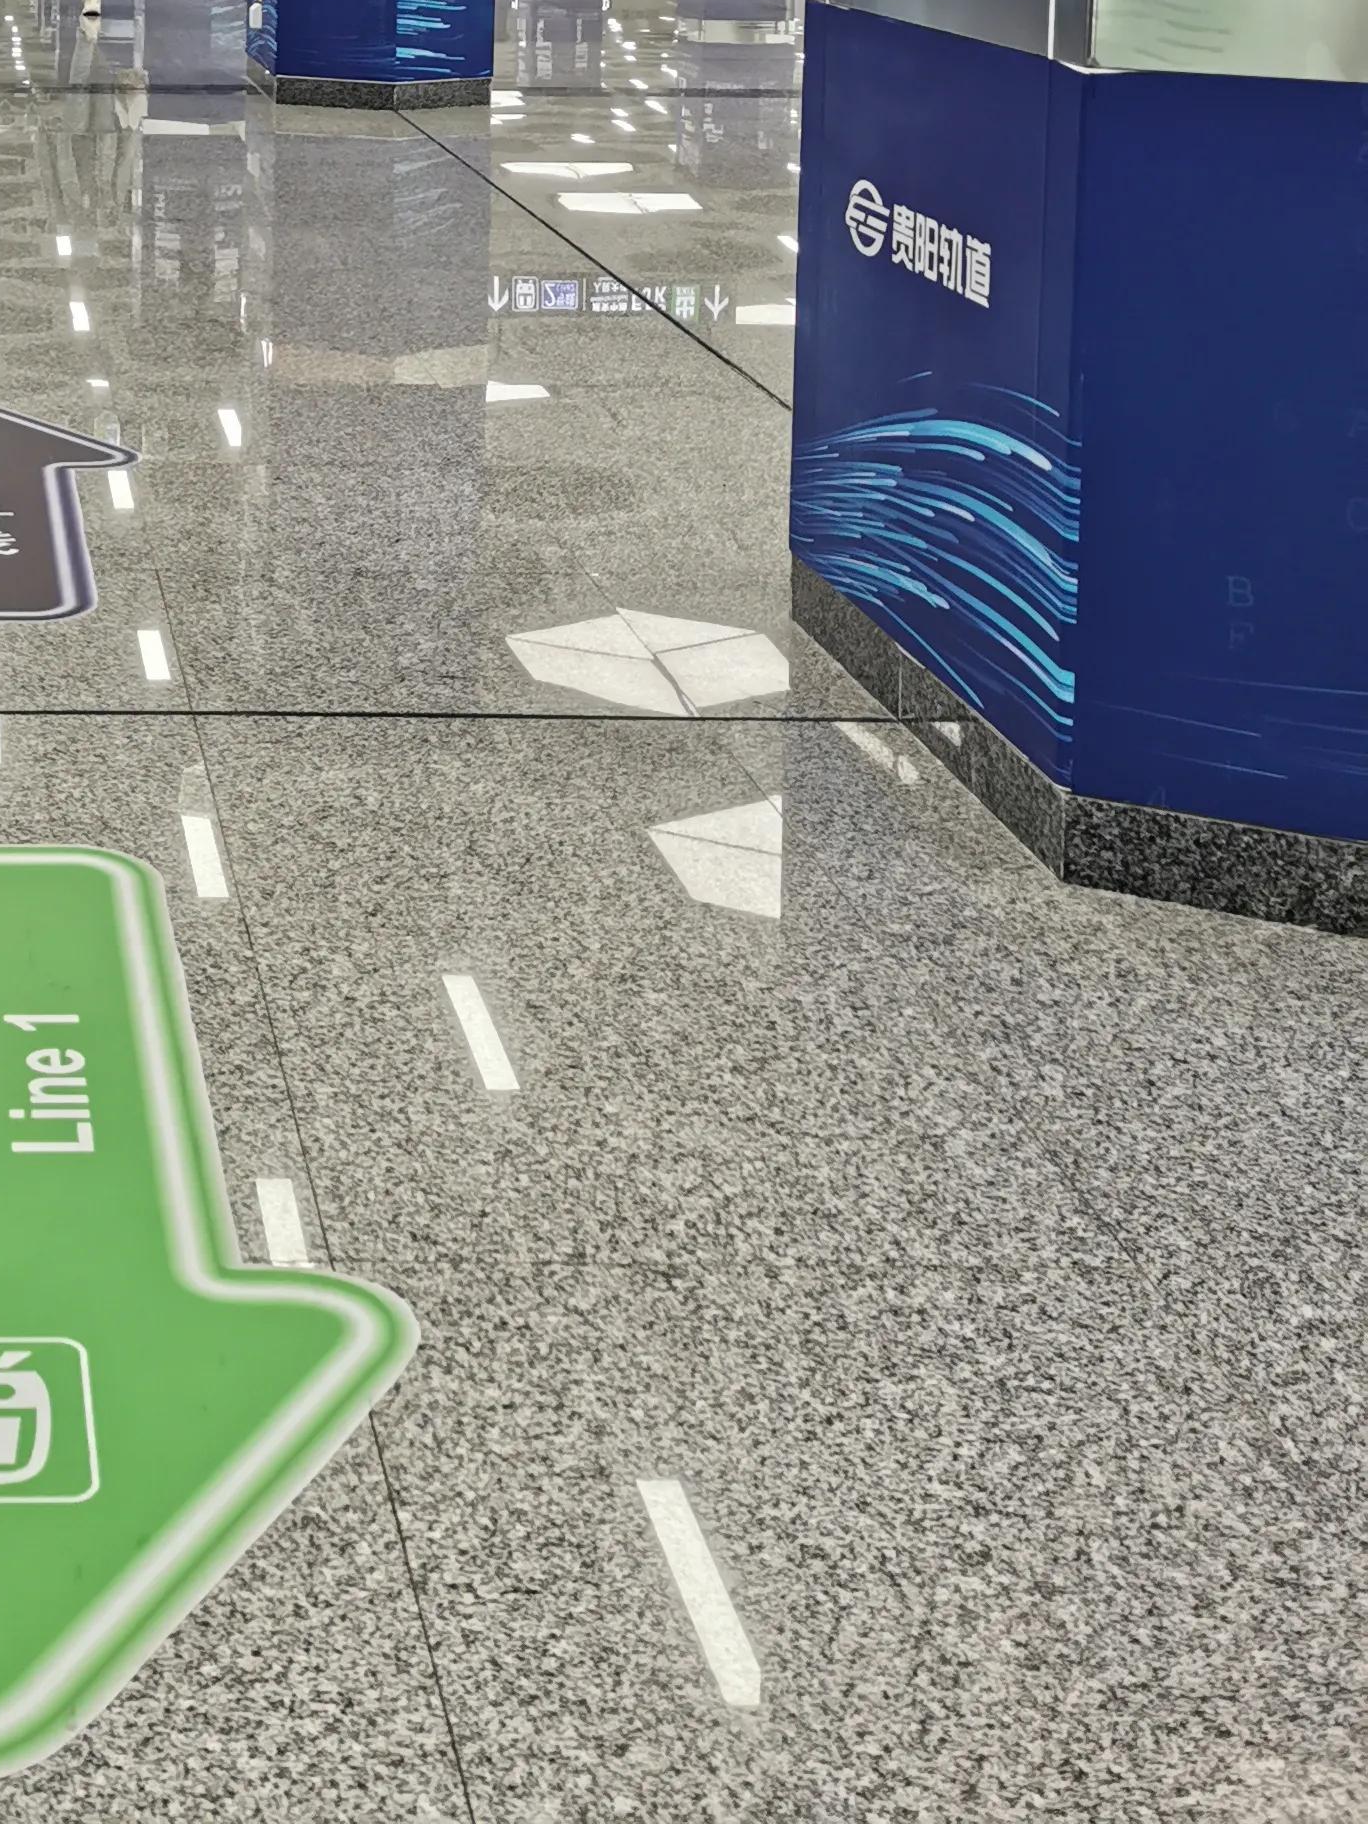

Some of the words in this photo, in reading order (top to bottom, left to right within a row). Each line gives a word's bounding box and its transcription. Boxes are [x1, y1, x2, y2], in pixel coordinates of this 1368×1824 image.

[892, 203, 992, 308] 贵阳轨道
[3, 1014, 80, 1031] 1
[9, 1048, 94, 1152] Line
